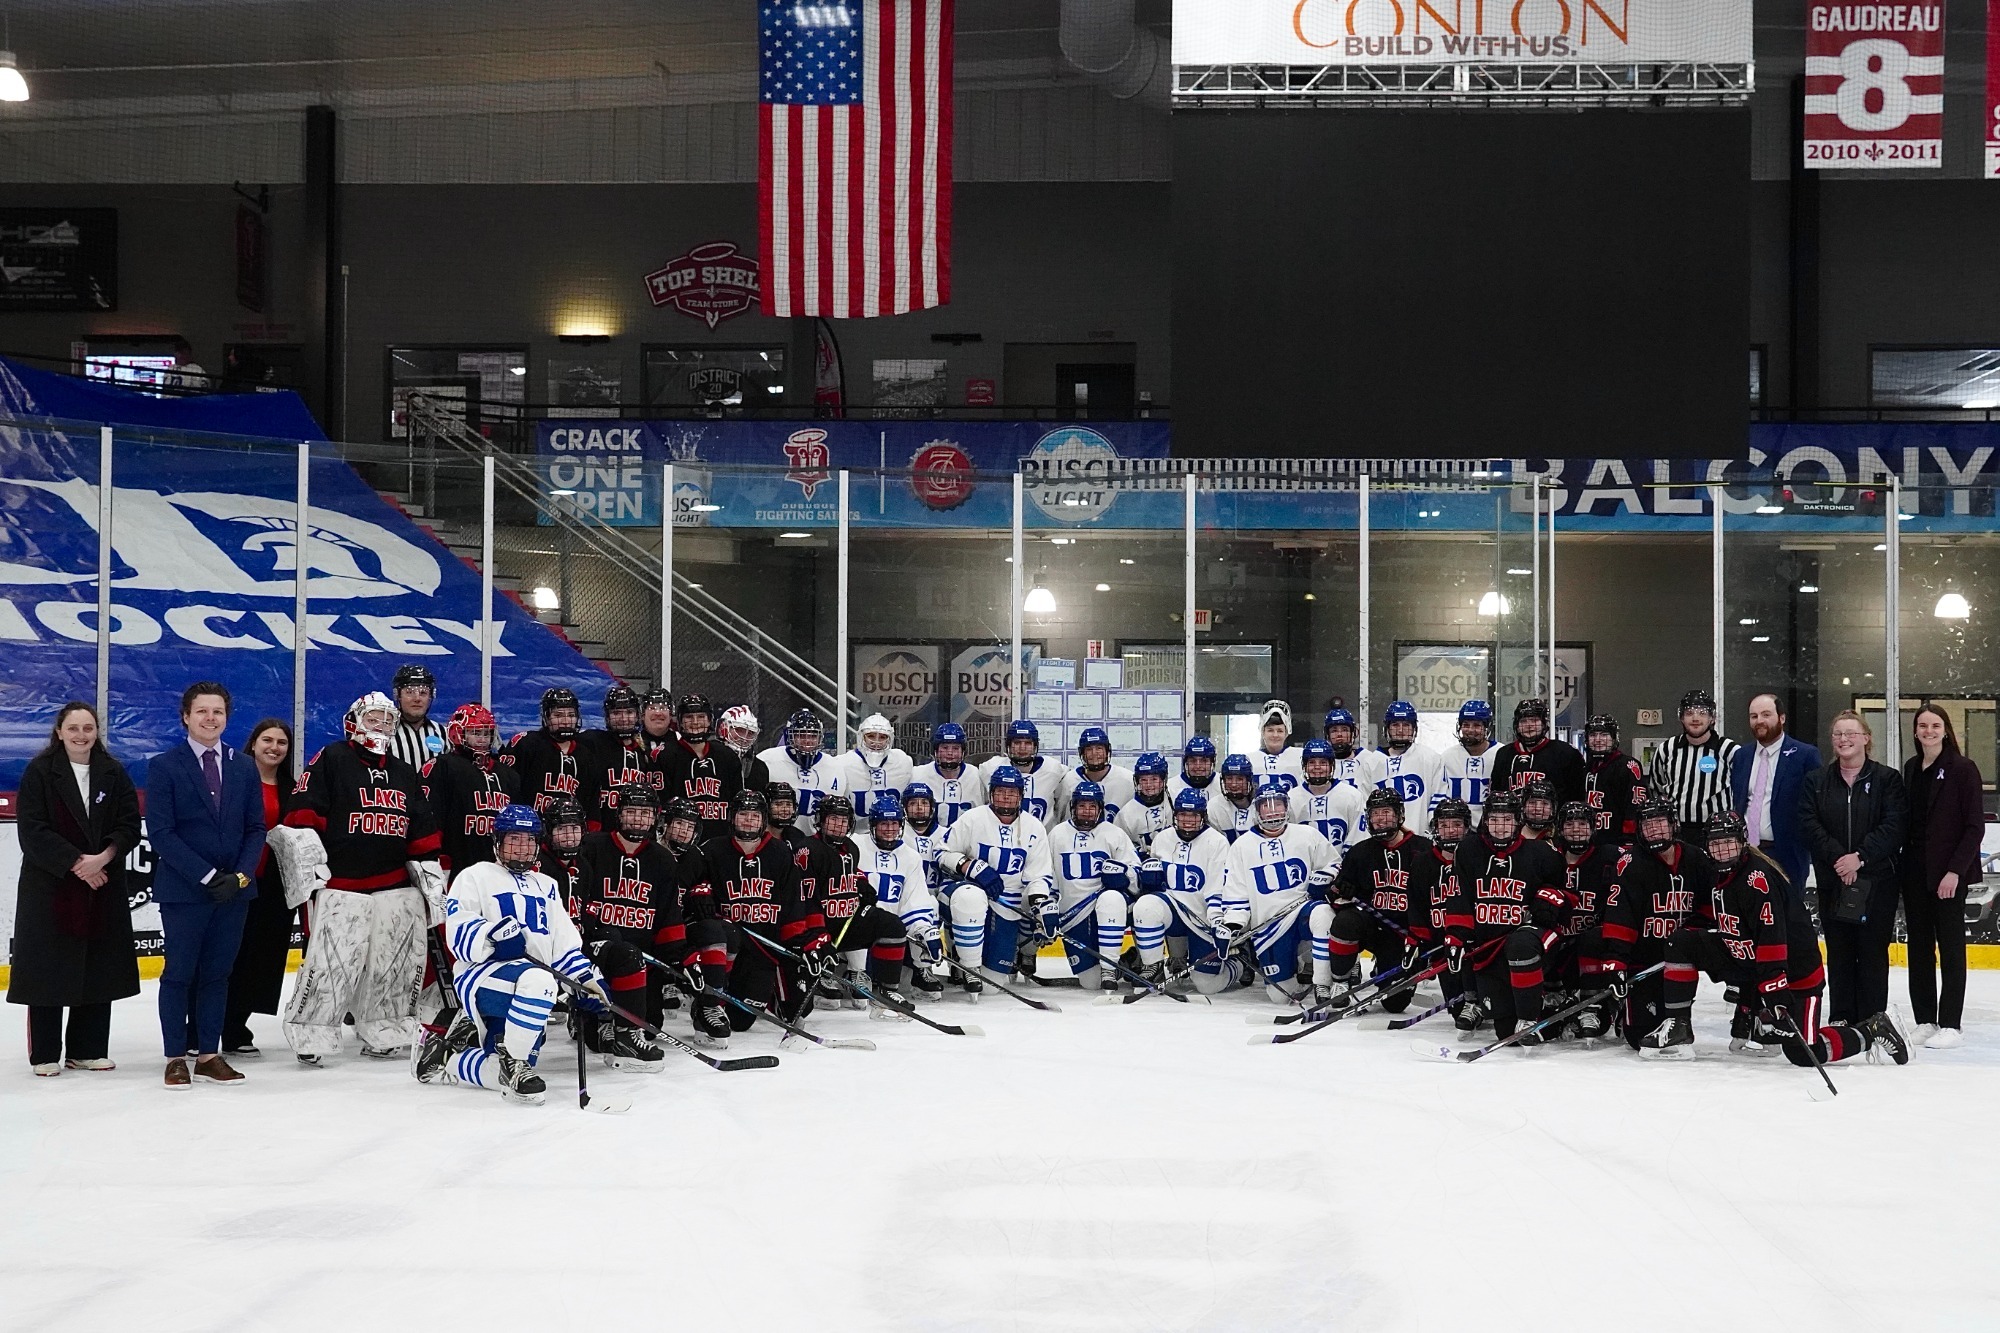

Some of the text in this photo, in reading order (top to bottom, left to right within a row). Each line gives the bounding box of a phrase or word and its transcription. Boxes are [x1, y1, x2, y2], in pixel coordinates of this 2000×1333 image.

[1811, 5, 1940, 32] GAUDREAU
[1344, 35, 1578, 57] BUILD WITH US.
[1836, 38, 1912, 132] 8
[1807, 144, 1939, 160] 2010 2011
[652, 266, 760, 295] TOP SHEL
[686, 299, 740, 308] TEAM STORE
[689, 368, 742, 391] DISTRICT
[709, 382, 722, 393] 20
[550, 428, 643, 450] CRACK
[550, 455, 643, 488] ONE
[1510, 446, 1995, 514] BALCONY
[550, 491, 643, 519] OPEN
[1042, 491, 1105, 506] LIGHT
[755, 510, 861, 520] FIGHTING SAITS
[1195, 611, 1208, 625] XIT
[862, 672, 937, 694] BUSCH
[1404, 674, 1482, 697] BUSCH
[878, 695, 923, 706] LIGHT
[974, 695, 1016, 706] LIGH
[1421, 697, 1463, 709] LIGHT
[545, 773, 580, 797] LAKE
[685, 778, 722, 798] LAKE
[1508, 771, 1546, 791] LAKE
[358, 787, 407, 811] LAKE
[474, 790, 511, 812] LAKE
[698, 801, 729, 820] REST
[548, 884, 557, 901] A
[603, 877, 652, 903] LAKE
[726, 878, 774, 900] LAKE
[829, 874, 858, 897] LAKE
[1476, 877, 1526, 901] LAKE
[1606, 884, 1621, 906] 2
[721, 903, 781, 924] FOREST
[1652, 891, 1694, 915] LAKE
[1760, 902, 1775, 925] 4
[1474, 903, 1529, 926] ORES
[1643, 916, 1681, 938] FOR
[1723, 938, 1756, 960] EST
